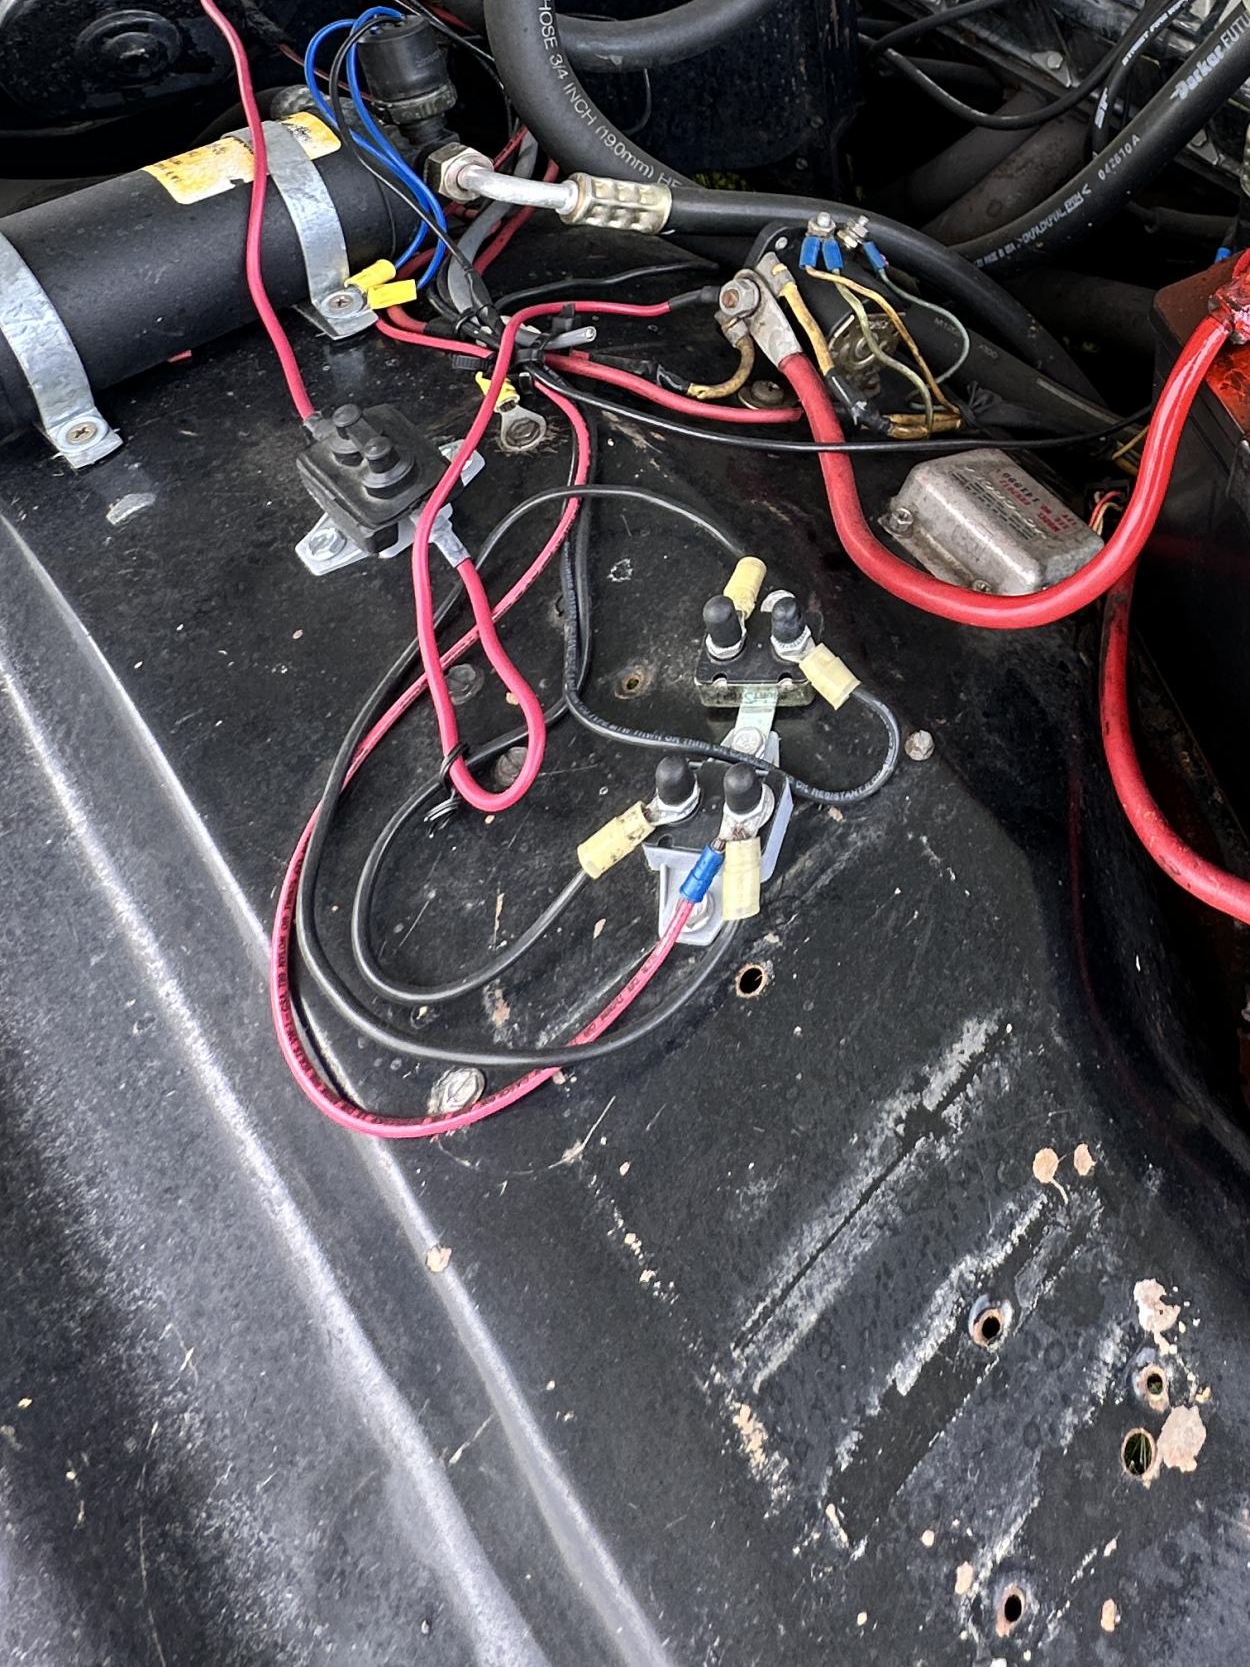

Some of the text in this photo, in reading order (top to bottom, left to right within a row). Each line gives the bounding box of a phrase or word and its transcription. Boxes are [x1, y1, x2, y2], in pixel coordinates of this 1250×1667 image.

[545, 53, 568, 79] 3/4
[563, 82, 596, 125] INCH
[1175, 44, 1220, 96] Parker
